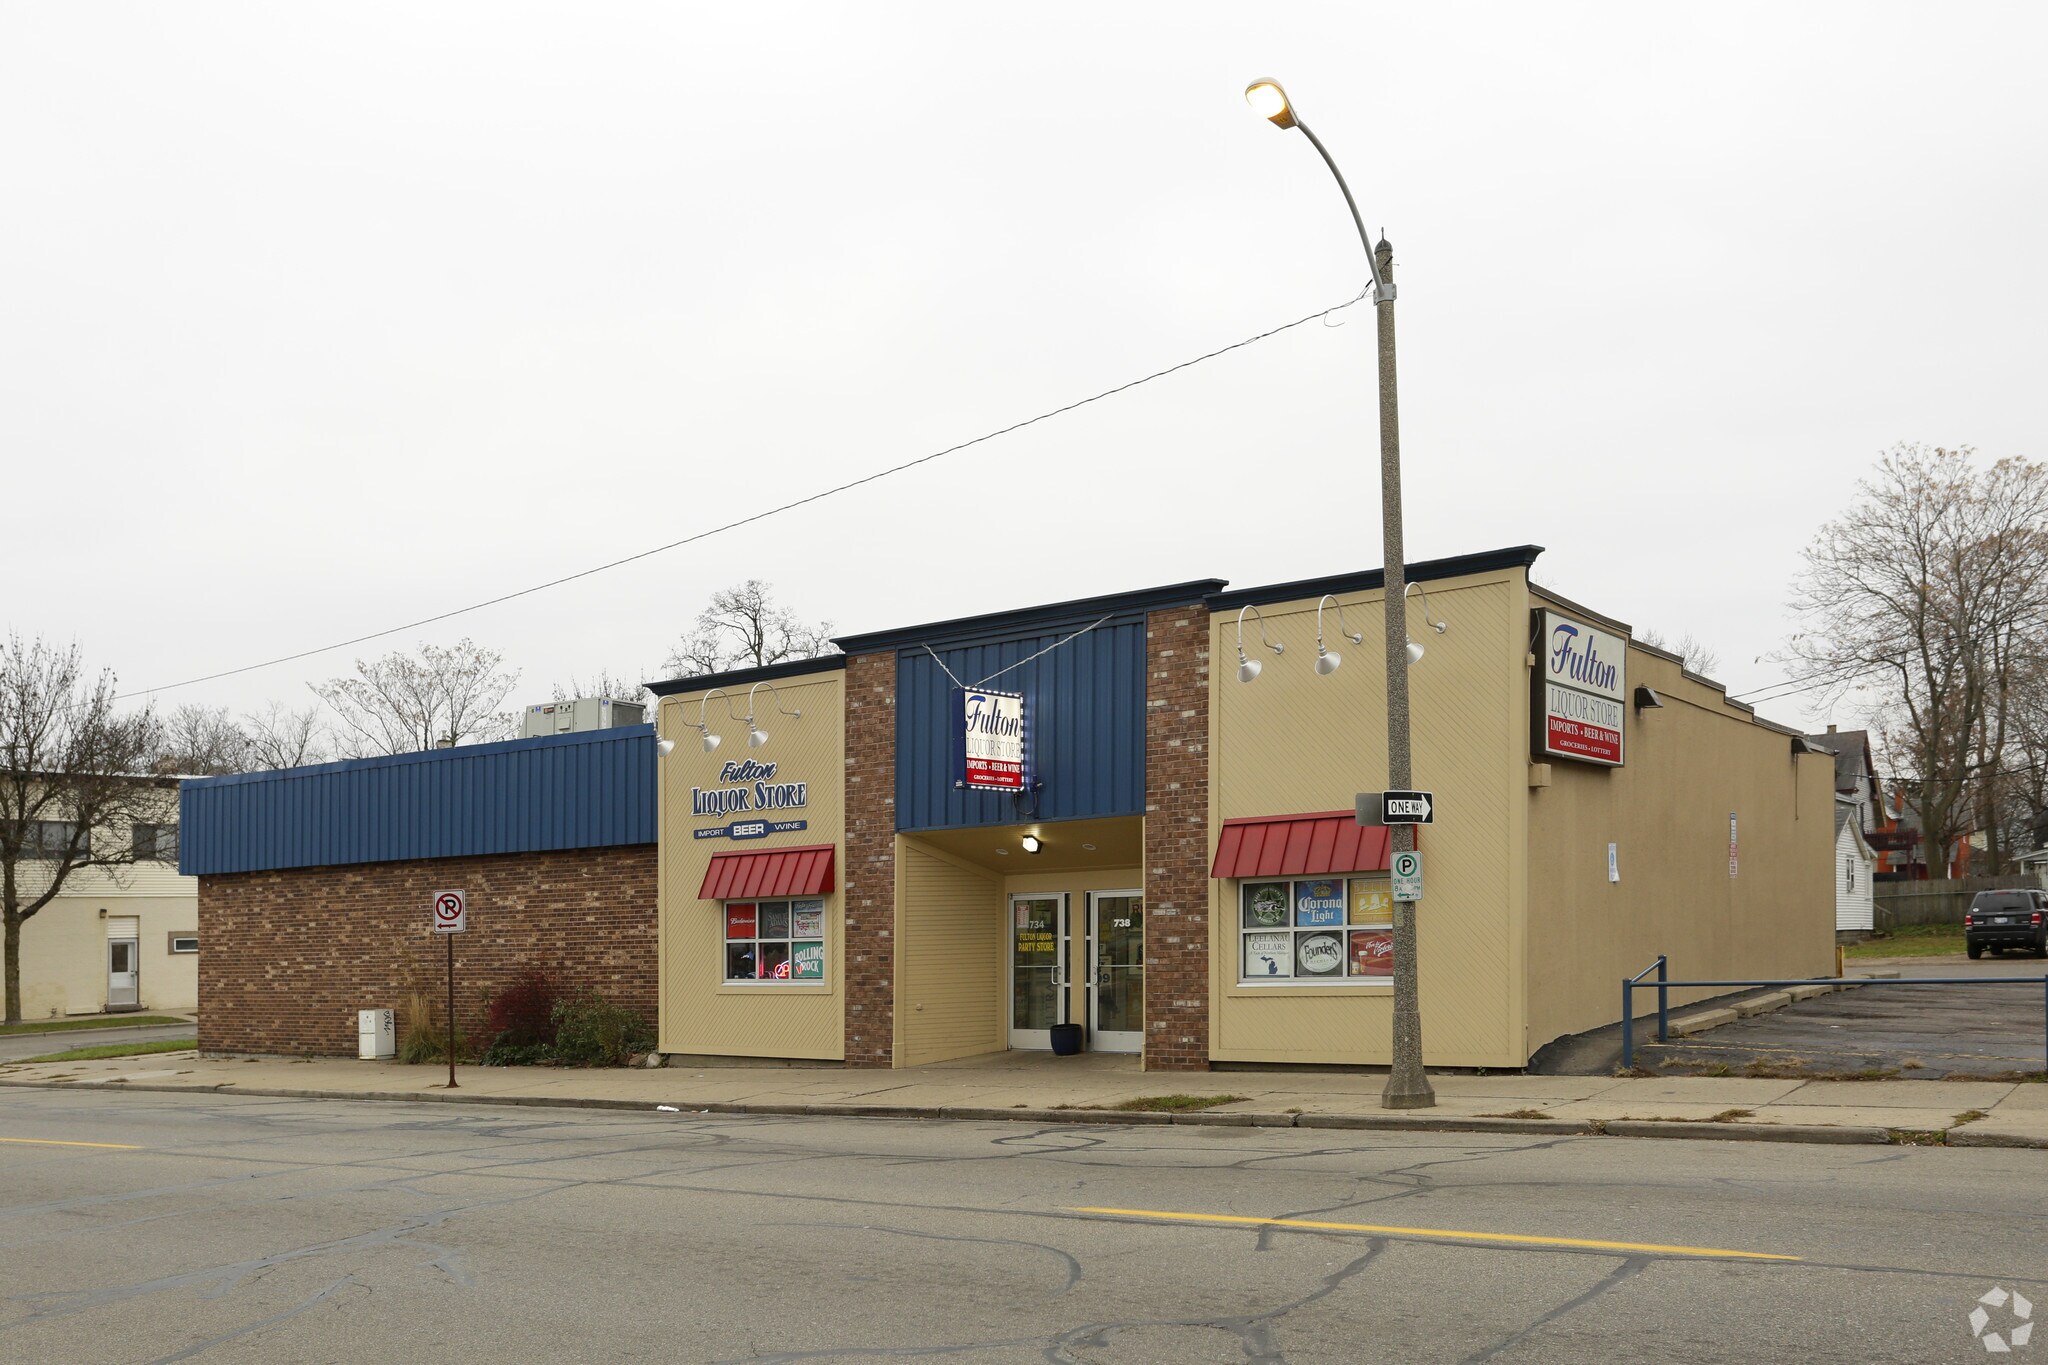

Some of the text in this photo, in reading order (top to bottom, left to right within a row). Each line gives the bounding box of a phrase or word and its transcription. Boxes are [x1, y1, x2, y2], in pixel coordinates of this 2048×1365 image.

[1551, 624, 1619, 692] Fulton
[1550, 688, 1618, 728] LIQUOR STORE
[965, 695, 1019, 737] Fulton
[1550, 718, 1619, 745] IMPORTS BEER & WINE
[966, 737, 1020, 759] LIQUOR STORE
[1559, 739, 1611, 756] GROCERIES LOTTERY
[719, 758, 778, 784] Fulton
[966, 759, 988, 771] IMPORTS
[991, 762, 1004, 772] BEER
[1007, 763, 1020, 773] WINE
[691, 780, 807, 819] LIQUOR STORE
[1391, 801, 1423, 814] ONE WAY
[698, 822, 801, 837] IMPORT BEER WINE
[1402, 859, 1412, 872] P
[1353, 881, 1391, 892] BELL
[1298, 896, 1342, 914] Corona
[1113, 918, 1131, 928] 738
[1311, 910, 1334, 923] Light
[1029, 920, 1045, 929] 734
[1036, 932, 1053, 941] LIQUOR
[794, 946, 823, 961] ROLLING
[1018, 942, 1055, 952] PARTY STORE
[1252, 941, 1286, 951] CELLARS
[1304, 941, 1338, 964] Founders
[802, 960, 819, 972] ROCK
